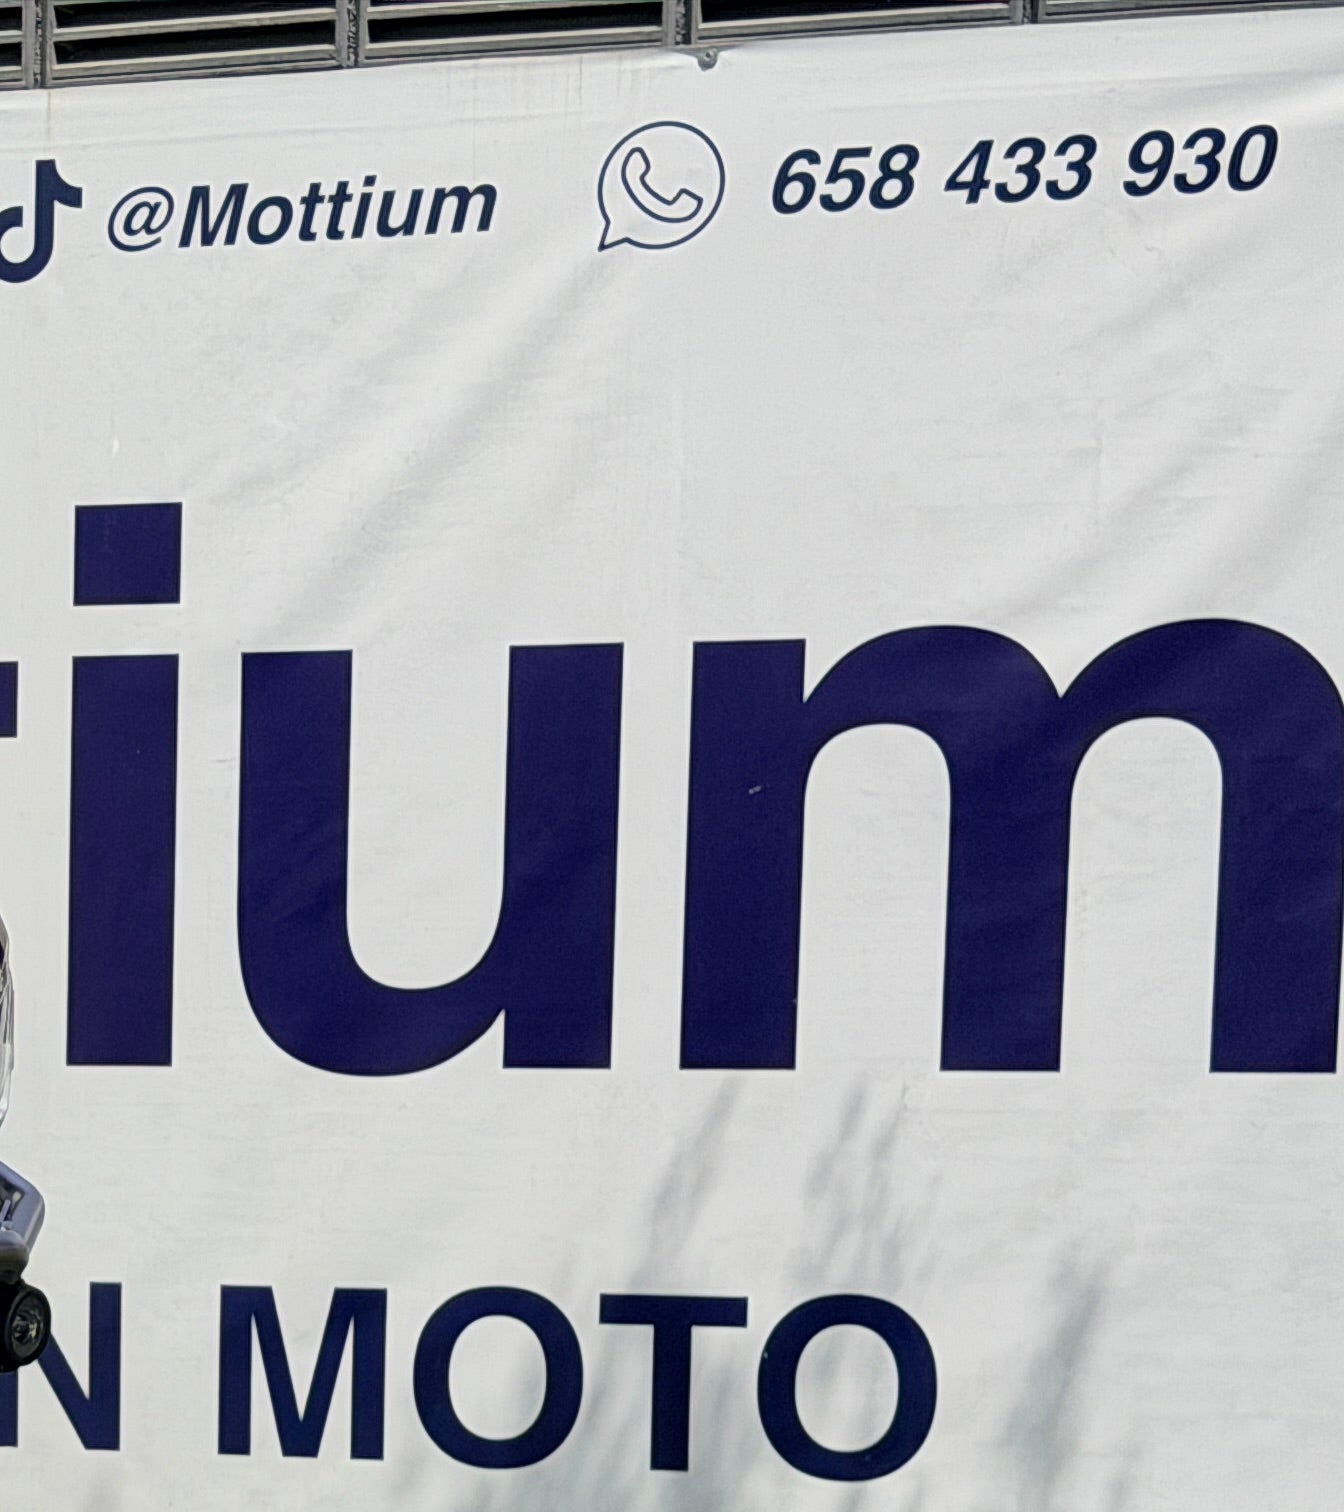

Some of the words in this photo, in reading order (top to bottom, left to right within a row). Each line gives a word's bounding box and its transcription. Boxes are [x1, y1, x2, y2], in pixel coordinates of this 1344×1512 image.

[108, 175, 497, 252] @Mottium
[773, 144, 919, 214] 658
[944, 135, 1097, 204] 433
[1123, 125, 1278, 196] 930
[218, 1285, 937, 1482] MOTO
